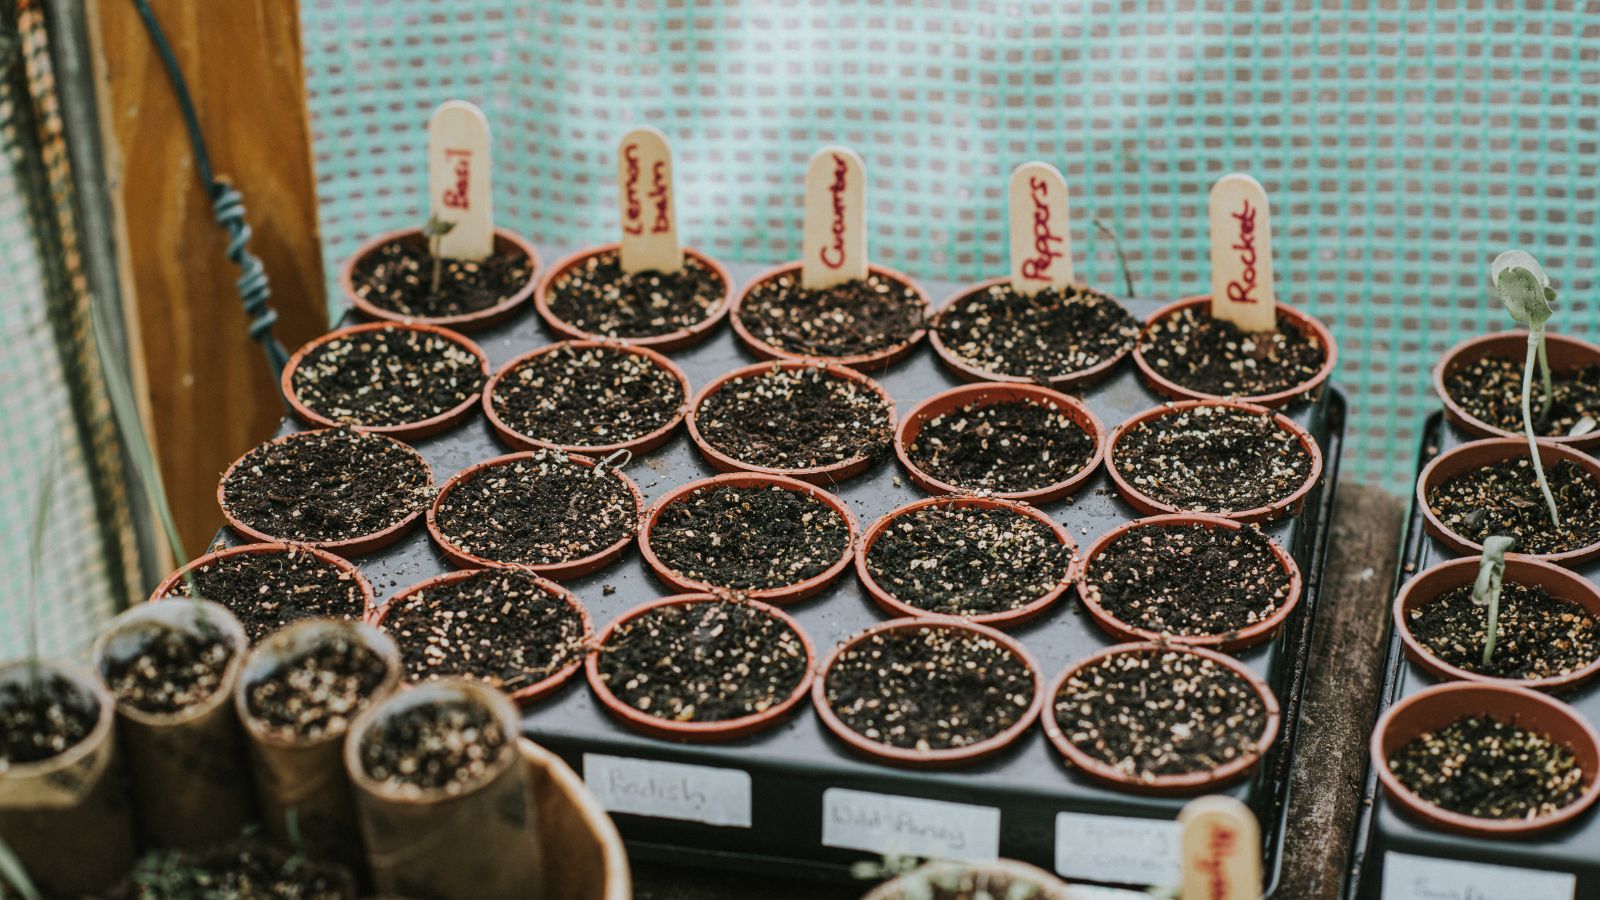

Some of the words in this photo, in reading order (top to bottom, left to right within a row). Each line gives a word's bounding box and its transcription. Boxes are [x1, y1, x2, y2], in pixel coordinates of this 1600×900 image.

[442, 148, 473, 211] Basil
[623, 143, 643, 237] Lemon
[648, 160, 671, 236] balm
[819, 153, 848, 271] Cucumber
[1020, 176, 1063, 283] Peppers
[1225, 199, 1259, 305] Rocket
